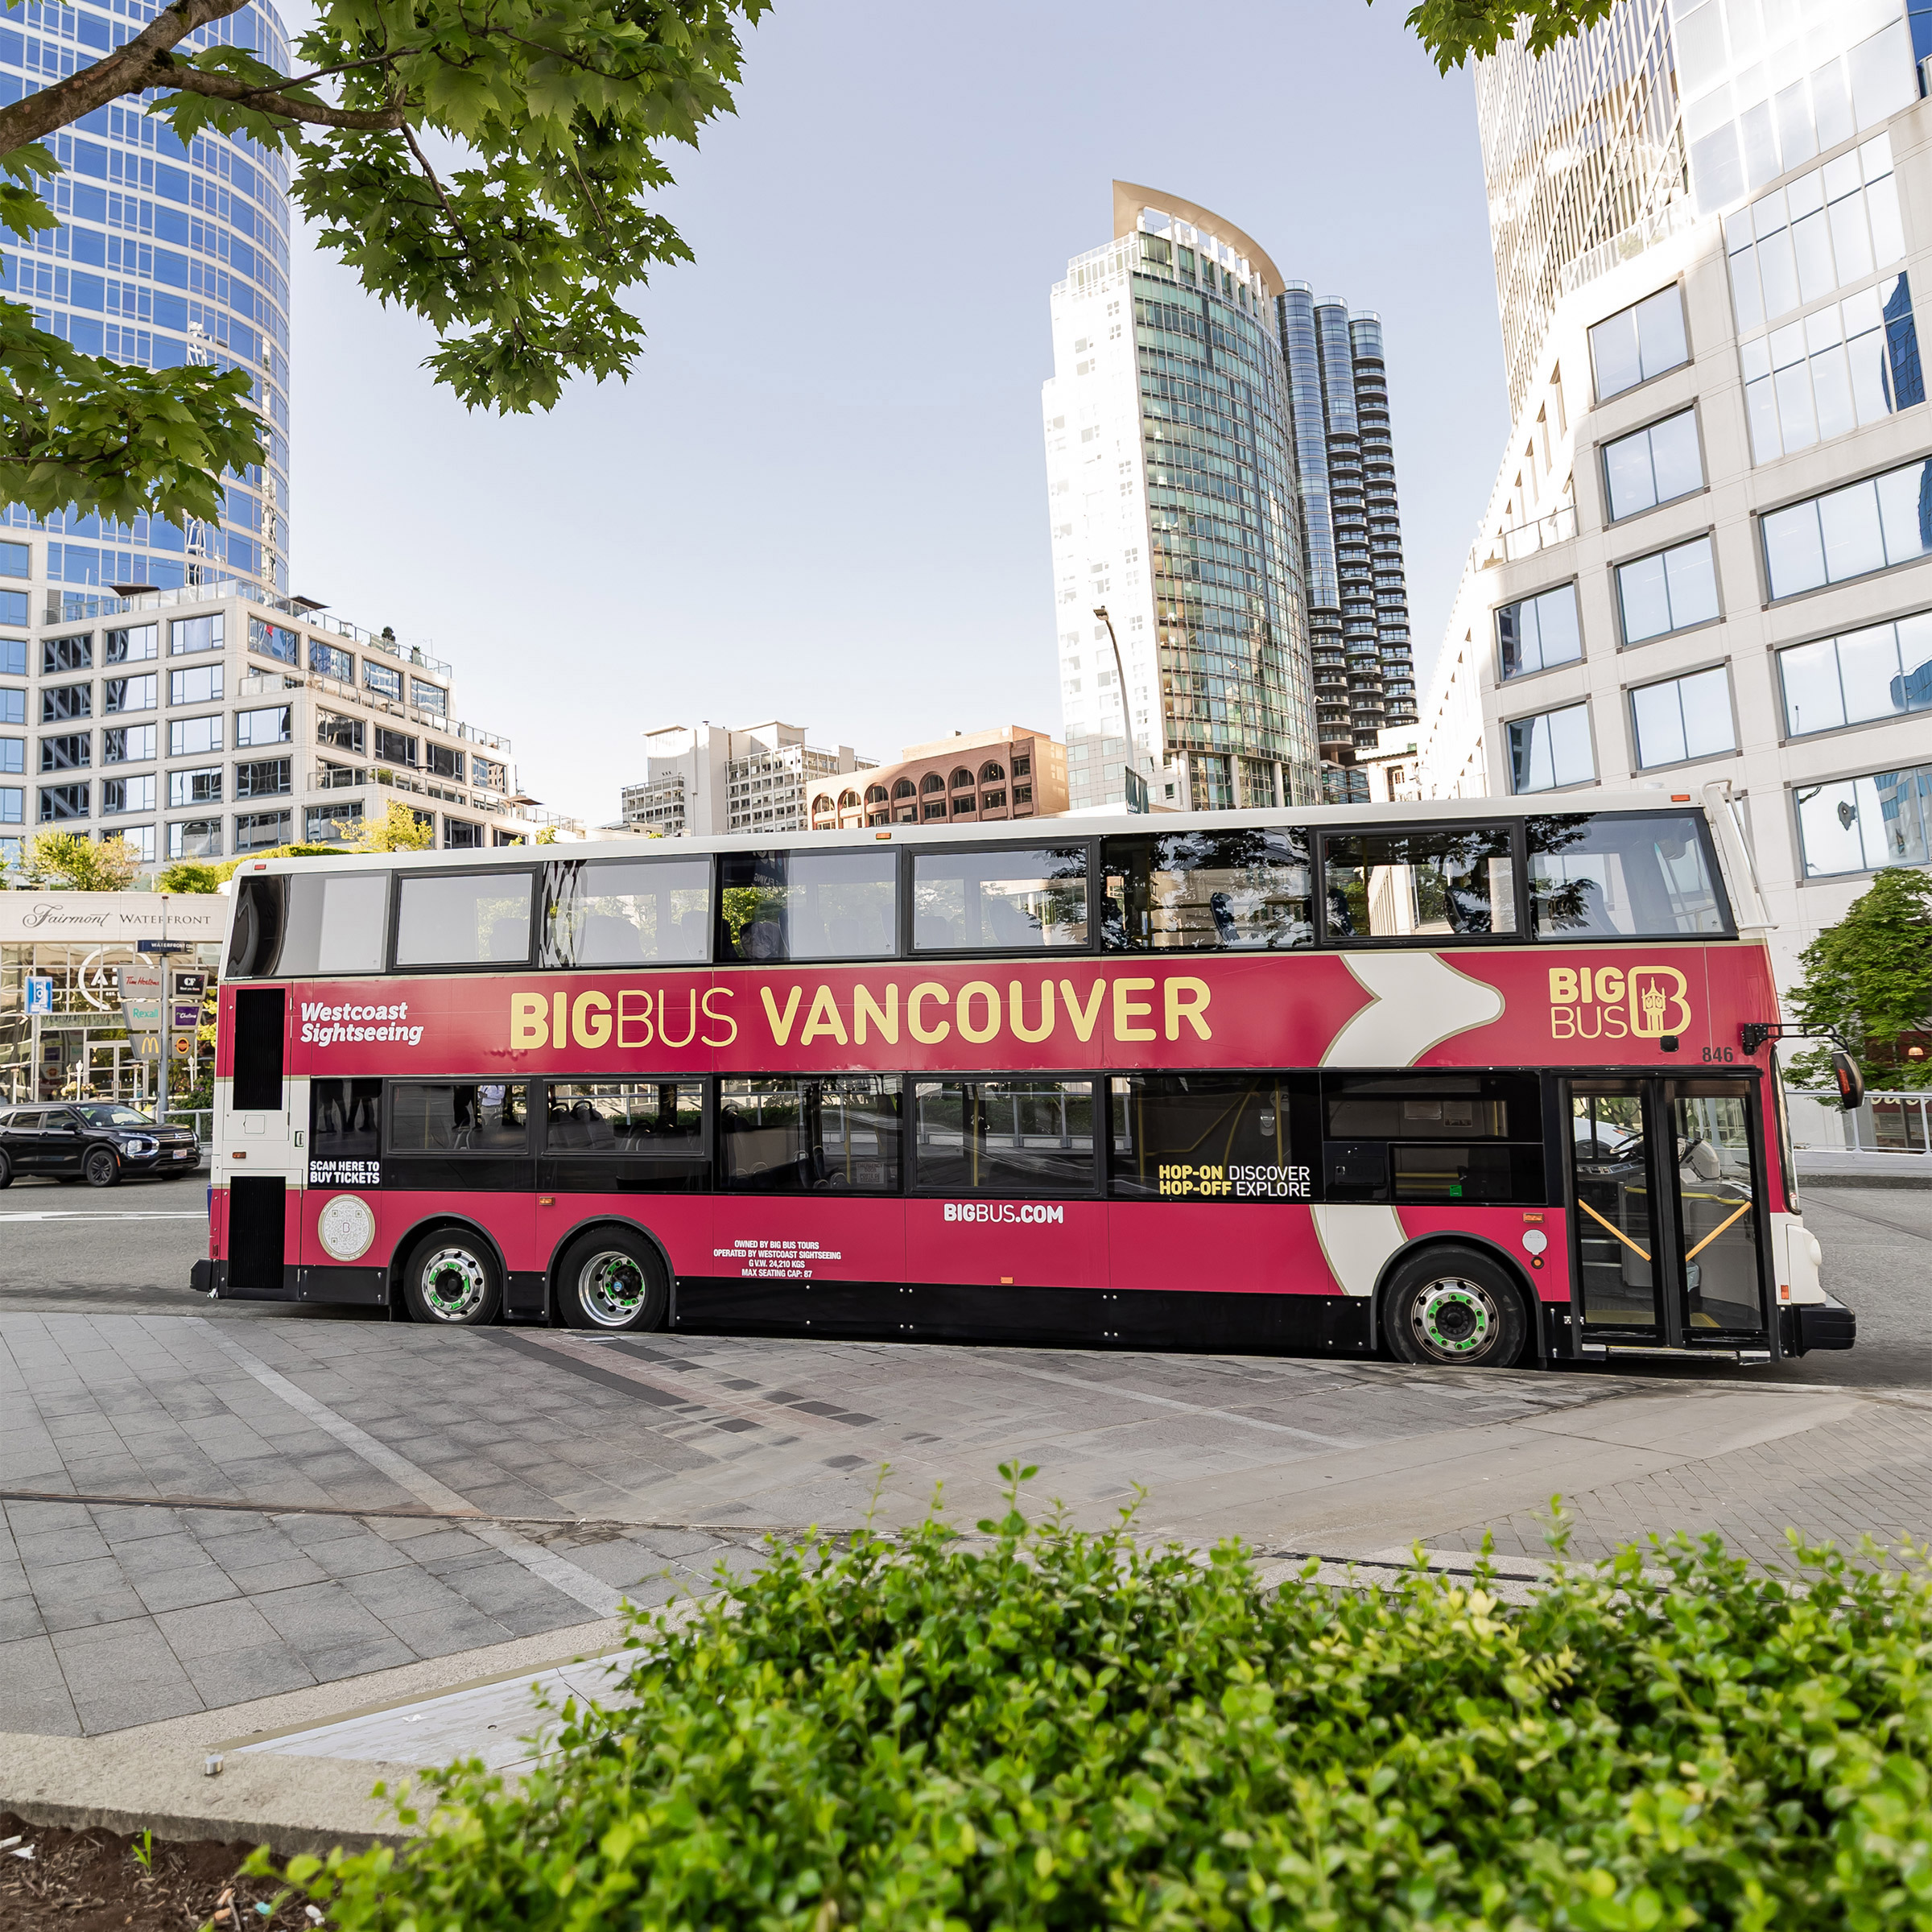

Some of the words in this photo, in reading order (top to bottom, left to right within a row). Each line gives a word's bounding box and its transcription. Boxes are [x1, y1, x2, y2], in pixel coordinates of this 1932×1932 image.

[23, 903, 112, 928] Fairmont
[120, 914, 211, 924] WATERFRONT
[126, 976, 137, 985] Tim
[138, 976, 159, 986] Hortons
[184, 977, 196, 986] CF
[1549, 966, 1625, 1004] BIG
[132, 1008, 158, 1019] Rexall
[301, 1001, 407, 1022] Westcoast
[510, 987, 737, 1050] BIGBUS
[760, 976, 1212, 1046] VANCOUVER
[1550, 1006, 1628, 1038] BUS
[300, 1022, 424, 1046] Sightseeing
[1702, 1046, 1734, 1063] 846
[309, 1161, 336, 1170] SCAN
[338, 1161, 365, 1172] HERE
[367, 1161, 380, 1172] TO
[1159, 1164, 1224, 1180] HOP-ON
[1228, 1165, 1311, 1182] DISCOVER
[310, 1171, 333, 1183] BUY
[334, 1172, 380, 1184] TICKETS
[1159, 1180, 1232, 1195] HOP-OFF
[1236, 1182, 1311, 1197] EXPLORE
[943, 1203, 1063, 1224] BIGBUS.COM
[734, 1240, 758, 1248] OWNED
[760, 1241, 768, 1249] BY
[770, 1241, 781, 1249] BIG
[782, 1241, 796, 1249] BUS
[797, 1241, 819, 1249] TOURS
[713, 1249, 746, 1257] OPERATED
[748, 1249, 757, 1257] BY
[758, 1249, 797, 1259] WESTCOAST
[799, 1251, 842, 1260] SIGHTSEEING
[769, 1260, 791, 1269] 24,210
[791, 1261, 805, 1269] KGS
[741, 1269, 758, 1277] MAX
[758, 1269, 786, 1278] SEATING
[787, 1270, 803, 1278] CAP:
[803, 1270, 813, 1278] 87
